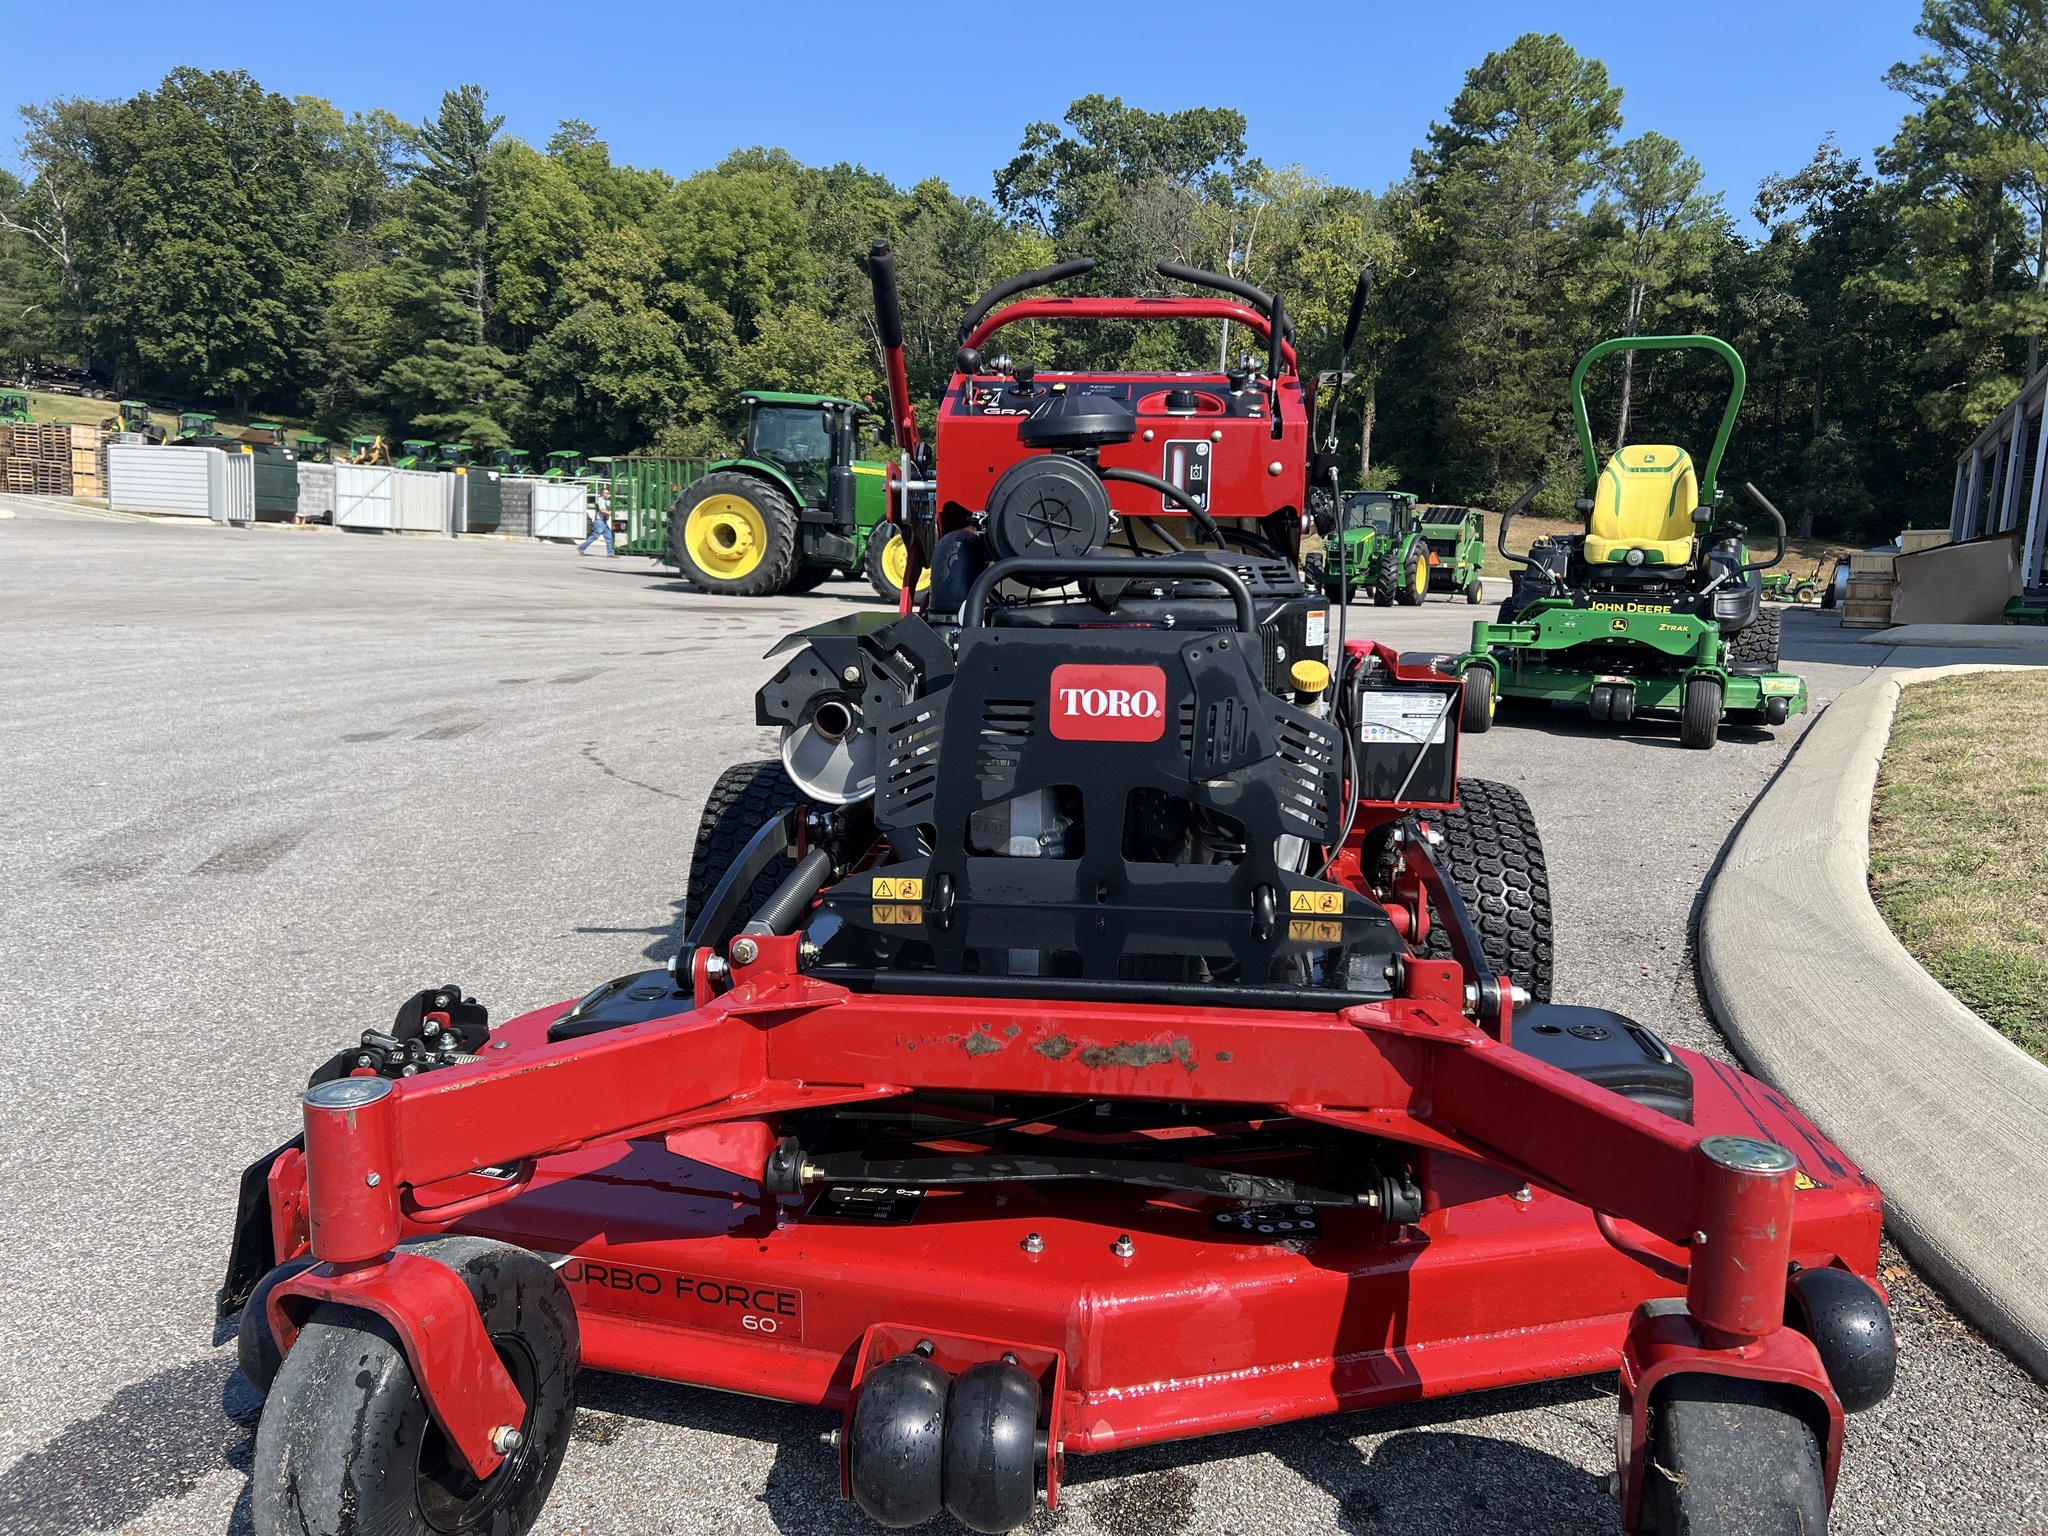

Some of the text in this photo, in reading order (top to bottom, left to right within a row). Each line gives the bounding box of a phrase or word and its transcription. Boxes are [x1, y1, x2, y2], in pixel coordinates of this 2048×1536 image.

[1588, 601, 1672, 614] JOHN DEERE
[1659, 623, 1690, 632] ZTRAK
[676, 1277, 797, 1317] FORCE
